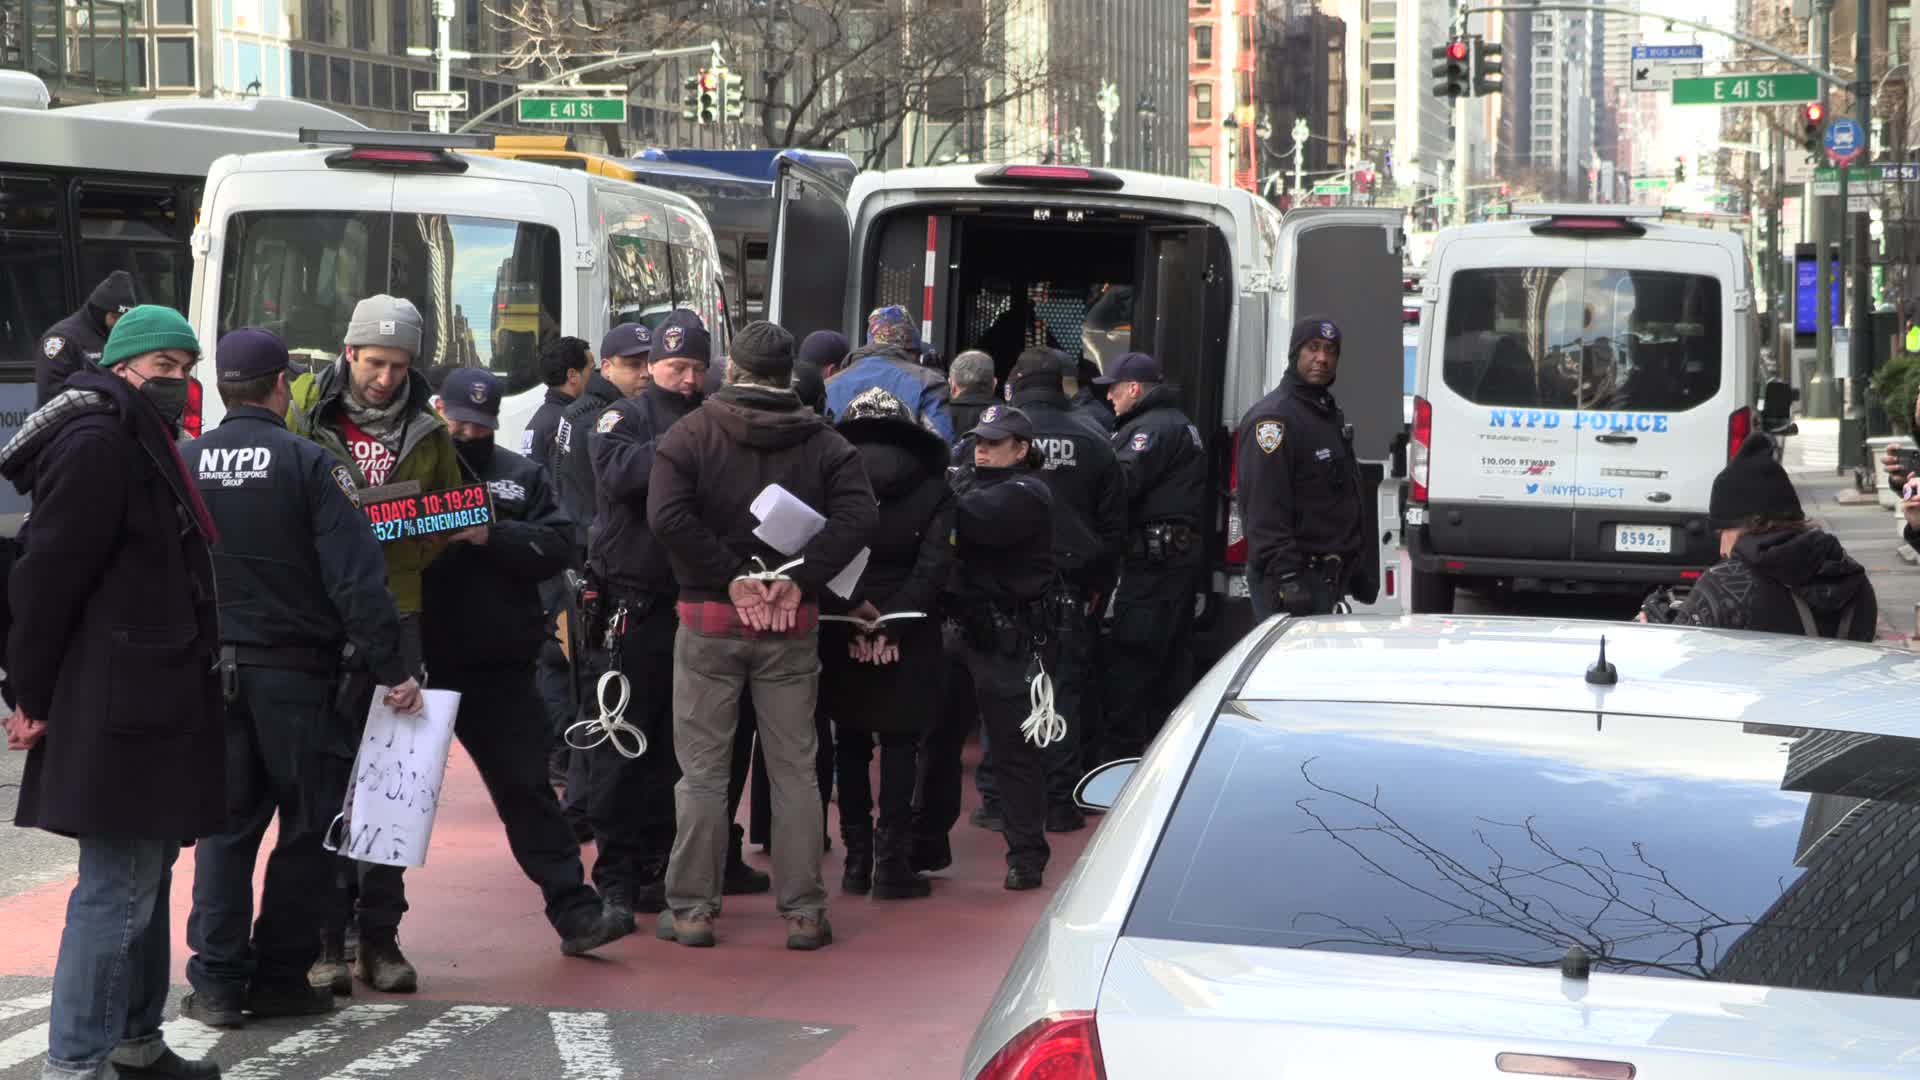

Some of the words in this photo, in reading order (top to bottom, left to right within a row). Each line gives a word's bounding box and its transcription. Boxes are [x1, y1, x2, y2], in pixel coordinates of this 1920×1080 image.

[1714, 81, 1725, 99] E
[1731, 79, 1750, 98] 41
[1757, 79, 1775, 98] St
[550, 103, 557, 117] E
[562, 102, 575, 117] 41
[580, 103, 594, 117] St
[1490, 409, 1560, 428] NYPD
[1573, 411, 1668, 432] POLICE
[199, 447, 271, 472] NYPD
[1031, 438, 1075, 460] YPD
[1481, 457, 1516, 466] $10,000
[199, 472, 232, 480] STRATEGIC
[235, 471, 268, 479] RESPONSE
[422, 487, 484, 514] 10:19:29
[416, 507, 489, 534] RENEWABLES
[1620, 532, 1655, 546] 8592
